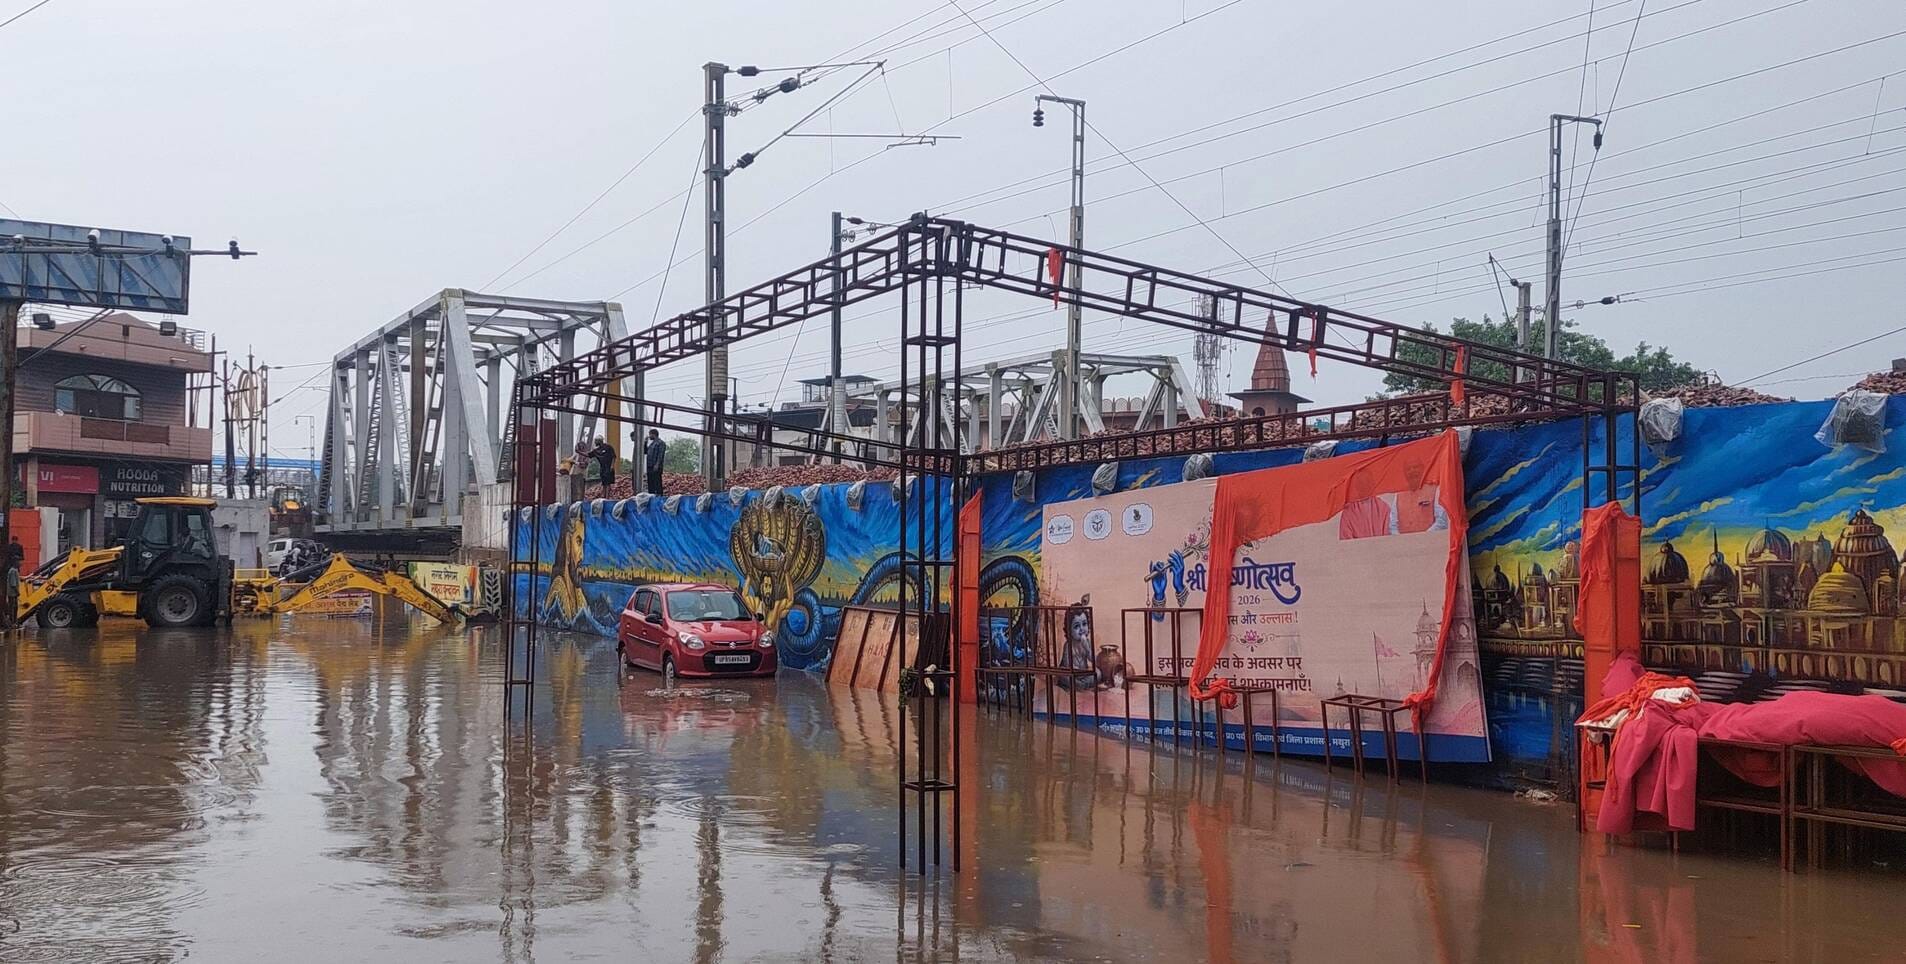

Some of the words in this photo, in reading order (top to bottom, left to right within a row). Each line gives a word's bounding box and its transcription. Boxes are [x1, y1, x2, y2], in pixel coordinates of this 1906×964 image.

[117, 468, 158, 481] HOODA
[111, 481, 164, 494] NUTRITION
[1238, 595, 1260, 605] 2026
[1232, 653, 1243, 669] के
[1247, 657, 1283, 670] अवसर
[1286, 657, 1302, 670] पर
